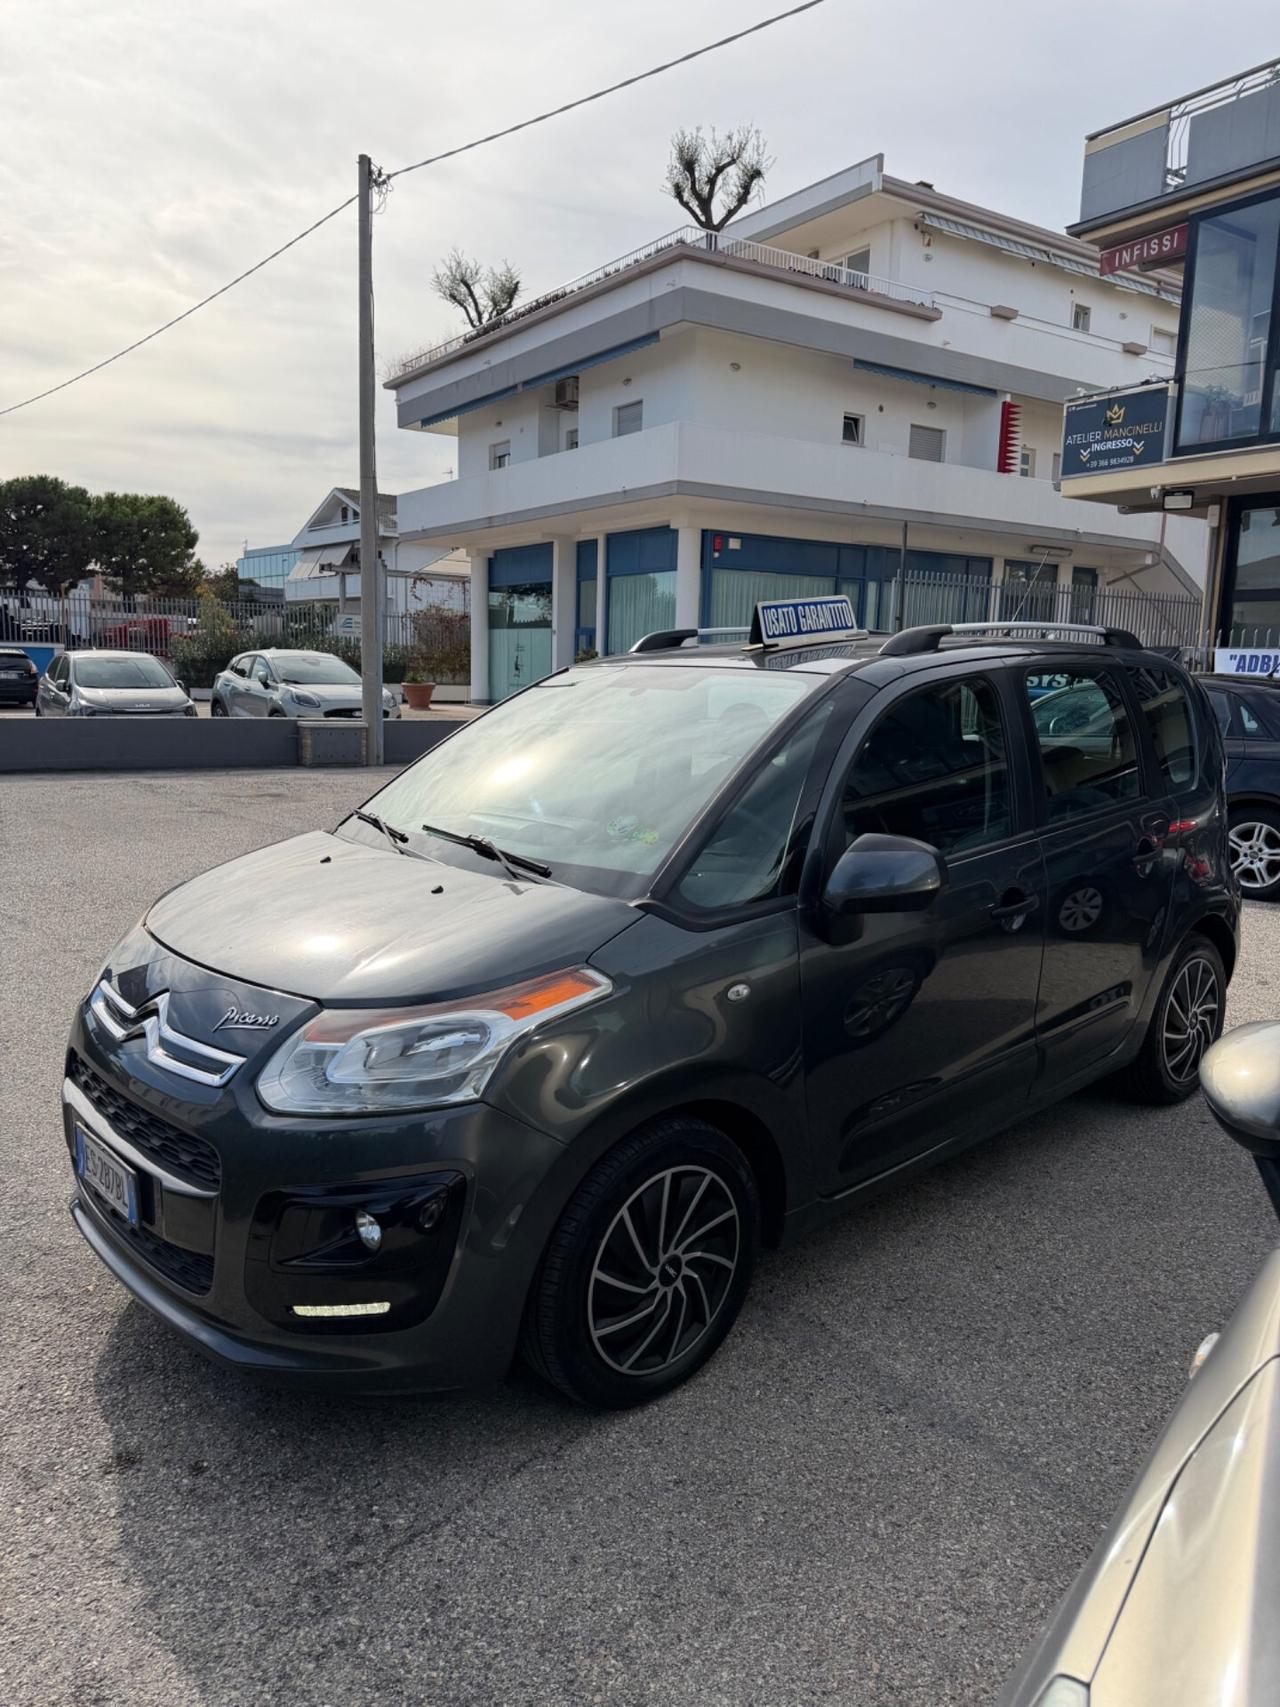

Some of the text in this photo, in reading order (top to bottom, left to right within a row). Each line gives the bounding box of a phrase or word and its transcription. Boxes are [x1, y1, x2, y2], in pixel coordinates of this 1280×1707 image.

[1115, 232, 1178, 267] INFISSI
[1066, 421, 1163, 446] ATELIER MANCINELLI
[1091, 438, 1133, 452] INGRESSO
[763, 602, 853, 636] USATO GARANTITO
[212, 1006, 280, 1033] Picasso
